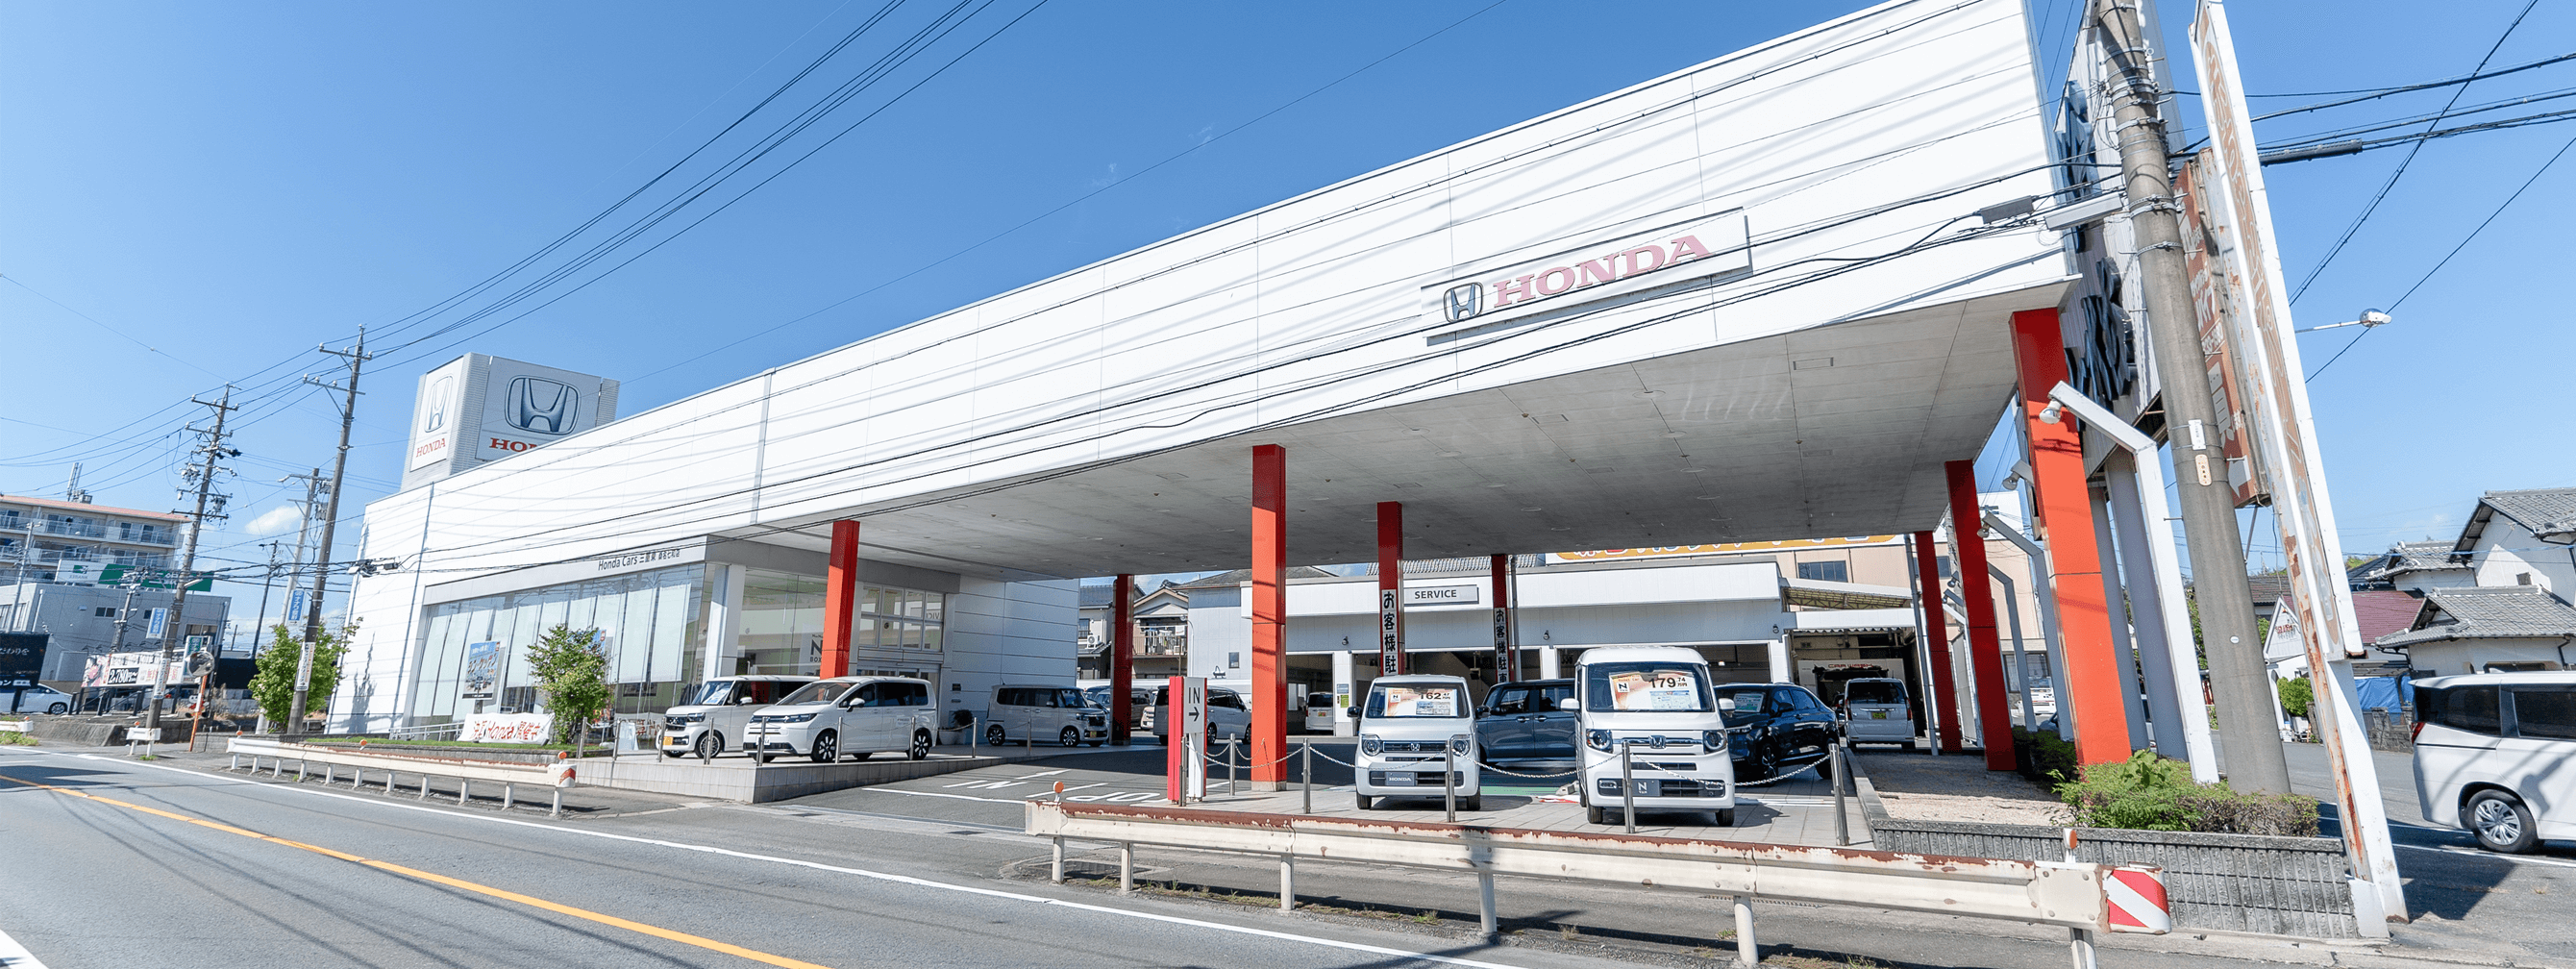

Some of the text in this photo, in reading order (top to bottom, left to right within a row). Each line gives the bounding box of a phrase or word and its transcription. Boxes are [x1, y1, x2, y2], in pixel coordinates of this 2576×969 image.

[1492, 235, 1717, 309] HONDA
[415, 437, 446, 458] HONDA
[598, 559, 621, 571] Honda
[622, 556, 638, 567] Cars
[1415, 589, 1457, 599] SERVICE
[1650, 677, 1676, 688] 179
[1188, 687, 1201, 704] IN
[1638, 782, 1647, 791] N
